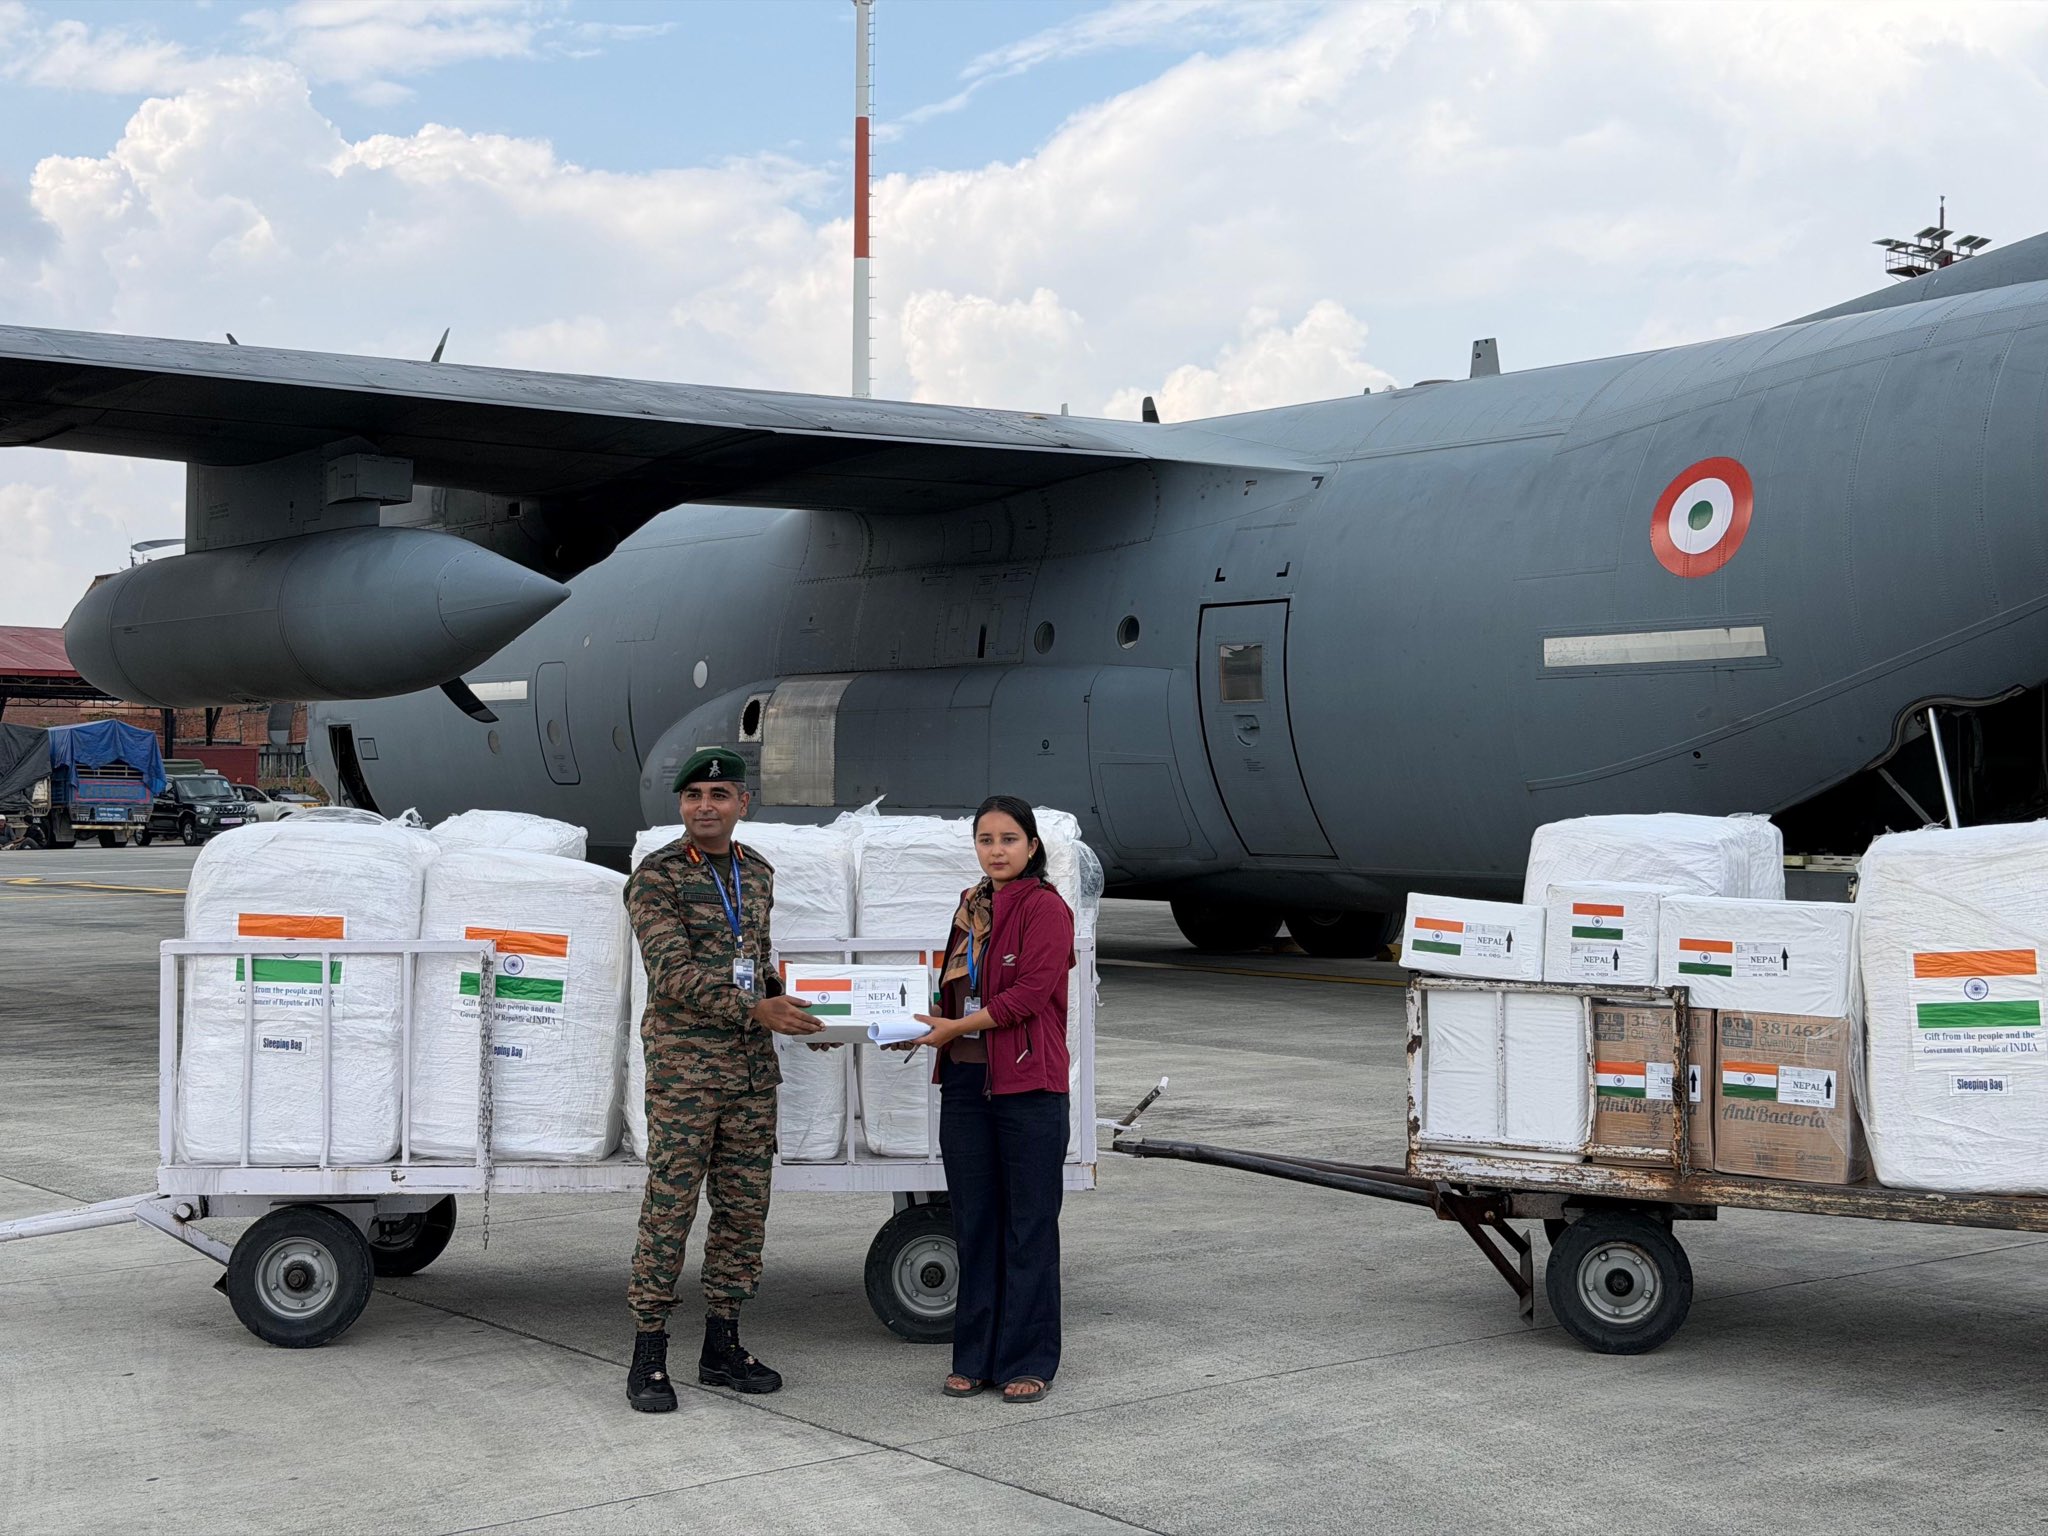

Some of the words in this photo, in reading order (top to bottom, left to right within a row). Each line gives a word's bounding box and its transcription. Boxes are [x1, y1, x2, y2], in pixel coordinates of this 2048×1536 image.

[1477, 936, 1504, 946] NEPAL
[1583, 955, 1611, 964] NEPAL
[1750, 955, 1780, 964] NEPAL
[255, 985, 271, 994] from
[272, 986, 283, 994] the
[284, 987, 307, 996] people
[308, 987, 322, 996] and
[868, 992, 897, 1001] NEPAL
[279, 998, 303, 1008] Republic
[462, 998, 476, 1007] Gift
[507, 1003, 530, 1013] people
[530, 1005, 544, 1013] and
[545, 1005, 556, 1014] the
[501, 1014, 525, 1023] Republic
[532, 1015, 556, 1025] INDIA
[1924, 1032, 1940, 1041] Gift
[1942, 1032, 1961, 1041] from
[1963, 1031, 1976, 1040] the
[1977, 1031, 2003, 1042] people
[2005, 1031, 2020, 1039] and
[2022, 1030, 2035, 1039] the
[263, 1037, 290, 1051] Sleeping
[290, 1039, 303, 1052] Bag
[1760, 1037, 1797, 1052] Quantity
[1923, 1046, 1963, 1054] Government
[1964, 1046, 1971, 1054] of
[1972, 1044, 2001, 1055] Republic
[2001, 1044, 2009, 1053] of
[2009, 1042, 2038, 1053] INDIA
[511, 1046, 523, 1059] Bag
[1792, 1080, 1823, 1092] NEPAL
[1956, 1078, 1988, 1092] Sleeping
[1989, 1078, 2003, 1092] Bag
